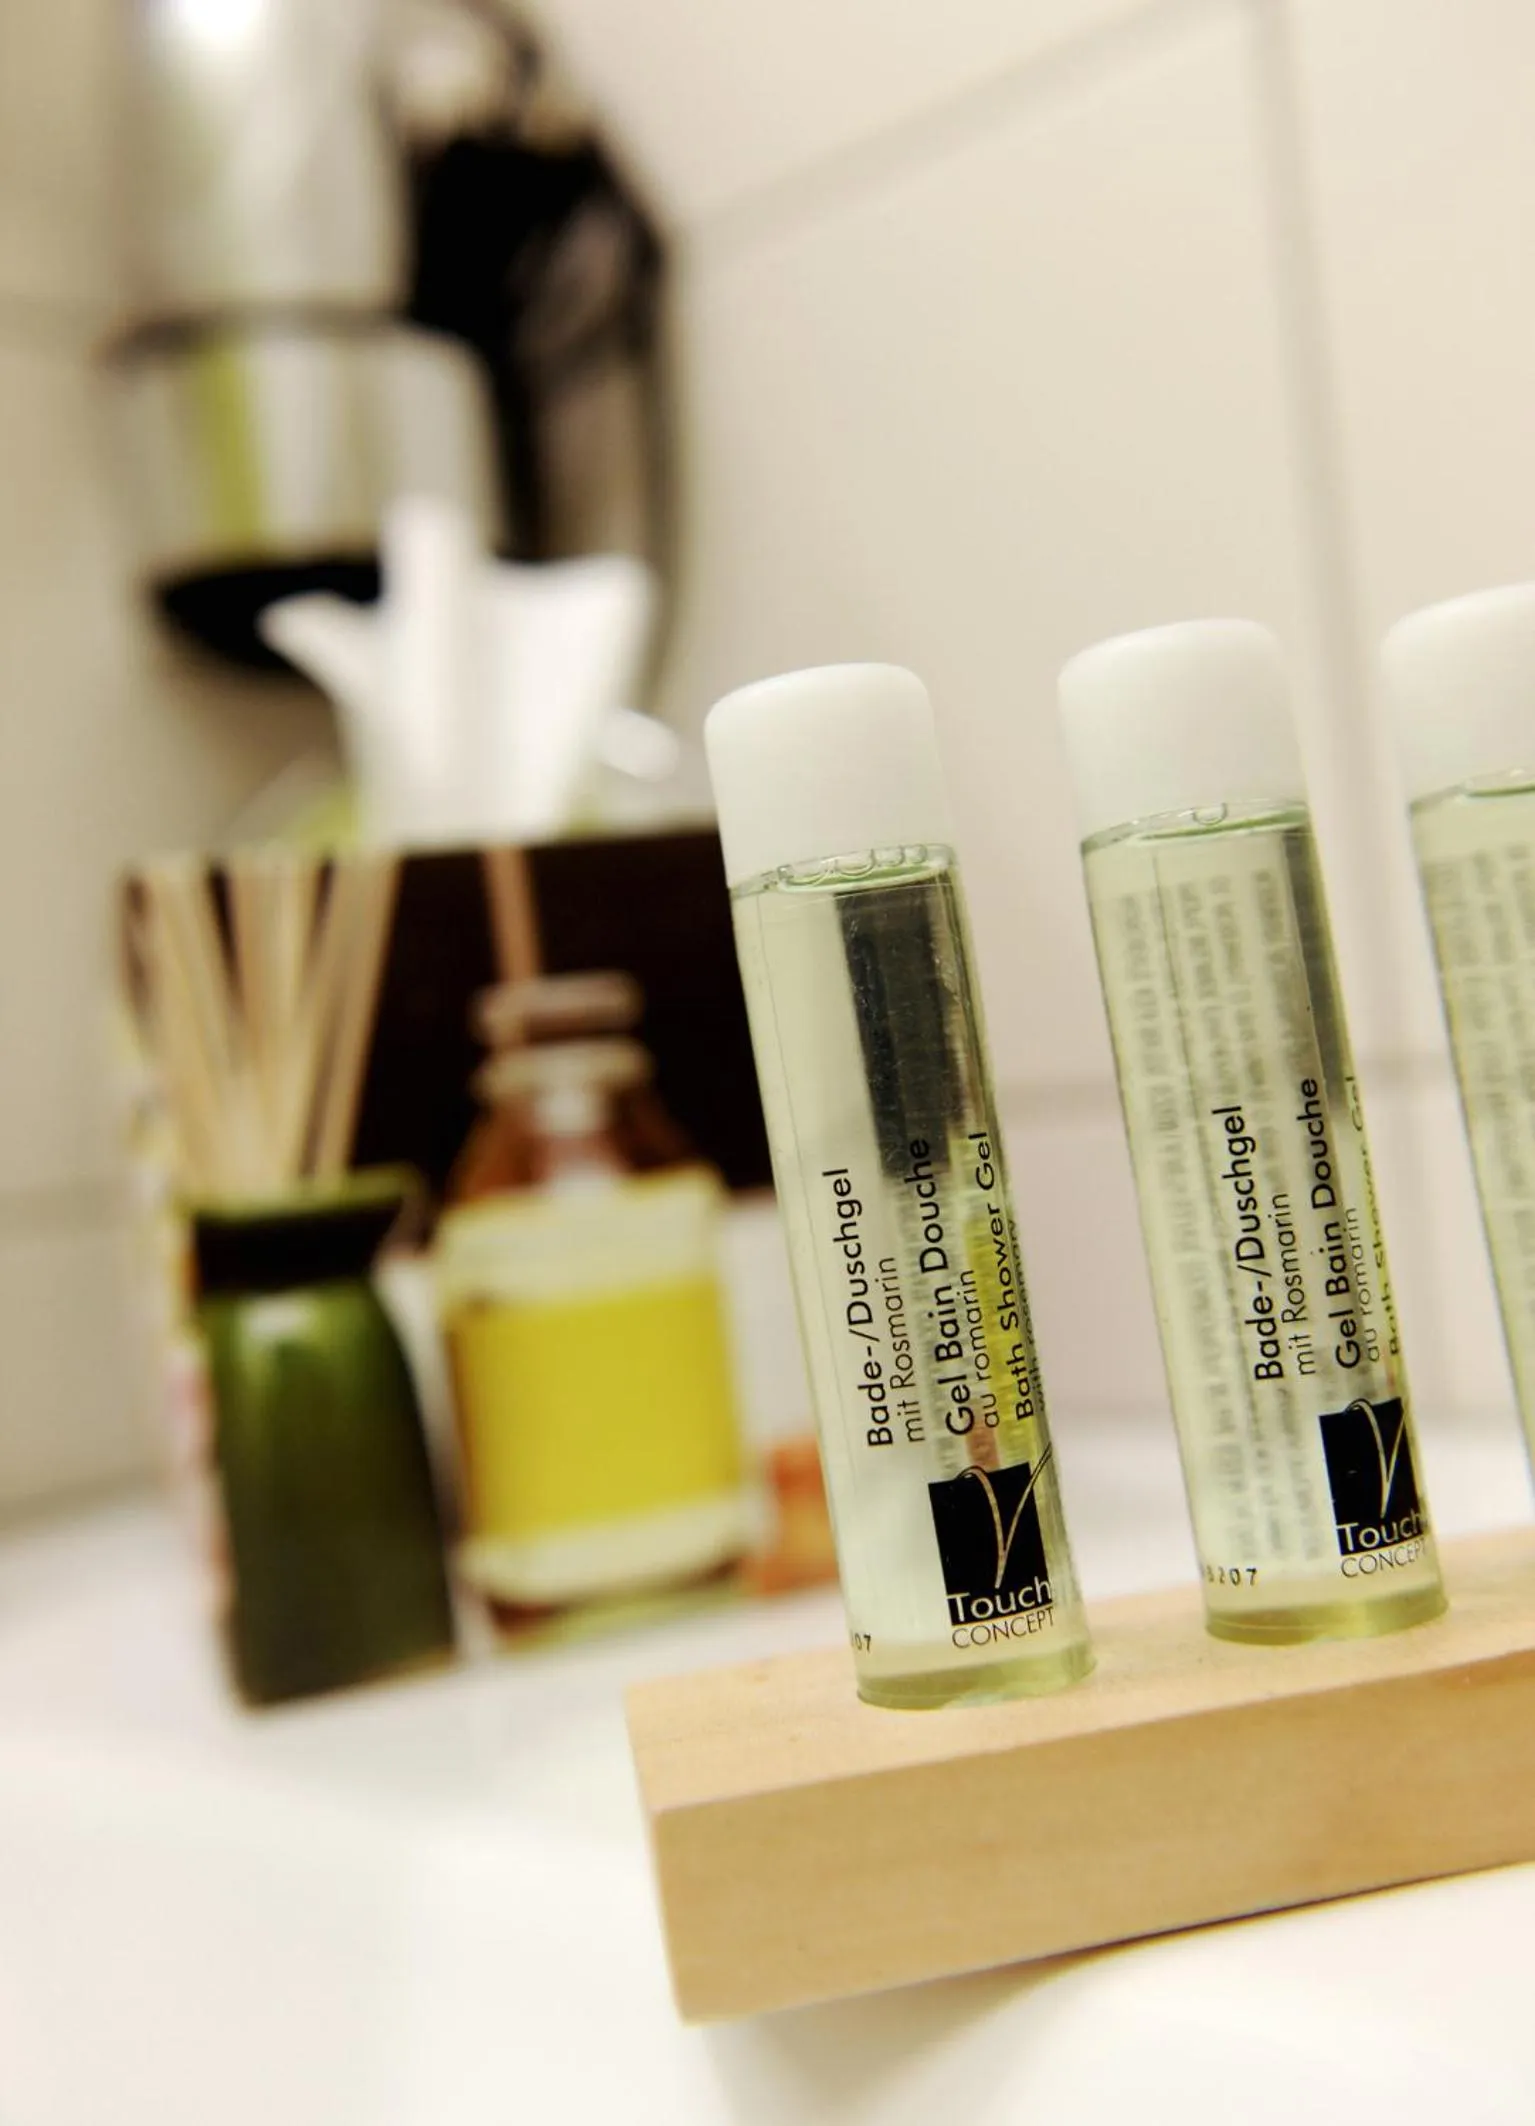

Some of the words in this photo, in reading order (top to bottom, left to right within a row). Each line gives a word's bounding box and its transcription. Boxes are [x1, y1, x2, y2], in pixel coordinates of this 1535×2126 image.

[968, 1131, 995, 1191] Gel
[1297, 1077, 1337, 1210] Douche
[904, 1137, 949, 1273] Douche
[1211, 1105, 1285, 1381] Bade-/Duschgel
[987, 1203, 1020, 1332] Shower
[1267, 1193, 1308, 1324] Rosmarin
[1318, 1221, 1350, 1297] Bain
[1342, 1207, 1374, 1317] romarin
[822, 1168, 894, 1446] Bade-/Duschgel
[875, 1257, 917, 1389] Rosmarin
[928, 1284, 963, 1363] Bain
[956, 1269, 992, 1381] romarin
[1328, 1309, 1361, 1369] Gel
[1358, 1327, 1380, 1362] au
[1006, 1343, 1034, 1421] Bath
[1288, 1334, 1316, 1375] mit
[897, 1400, 925, 1442] mit
[937, 1374, 975, 1436] Gel
[977, 1393, 999, 1428] au
[1336, 1508, 1425, 1552] Touch
[1341, 1537, 1427, 1579] CONCEPT
[947, 1575, 1053, 1622] Touch
[951, 1606, 1055, 1650] CONCEPT
